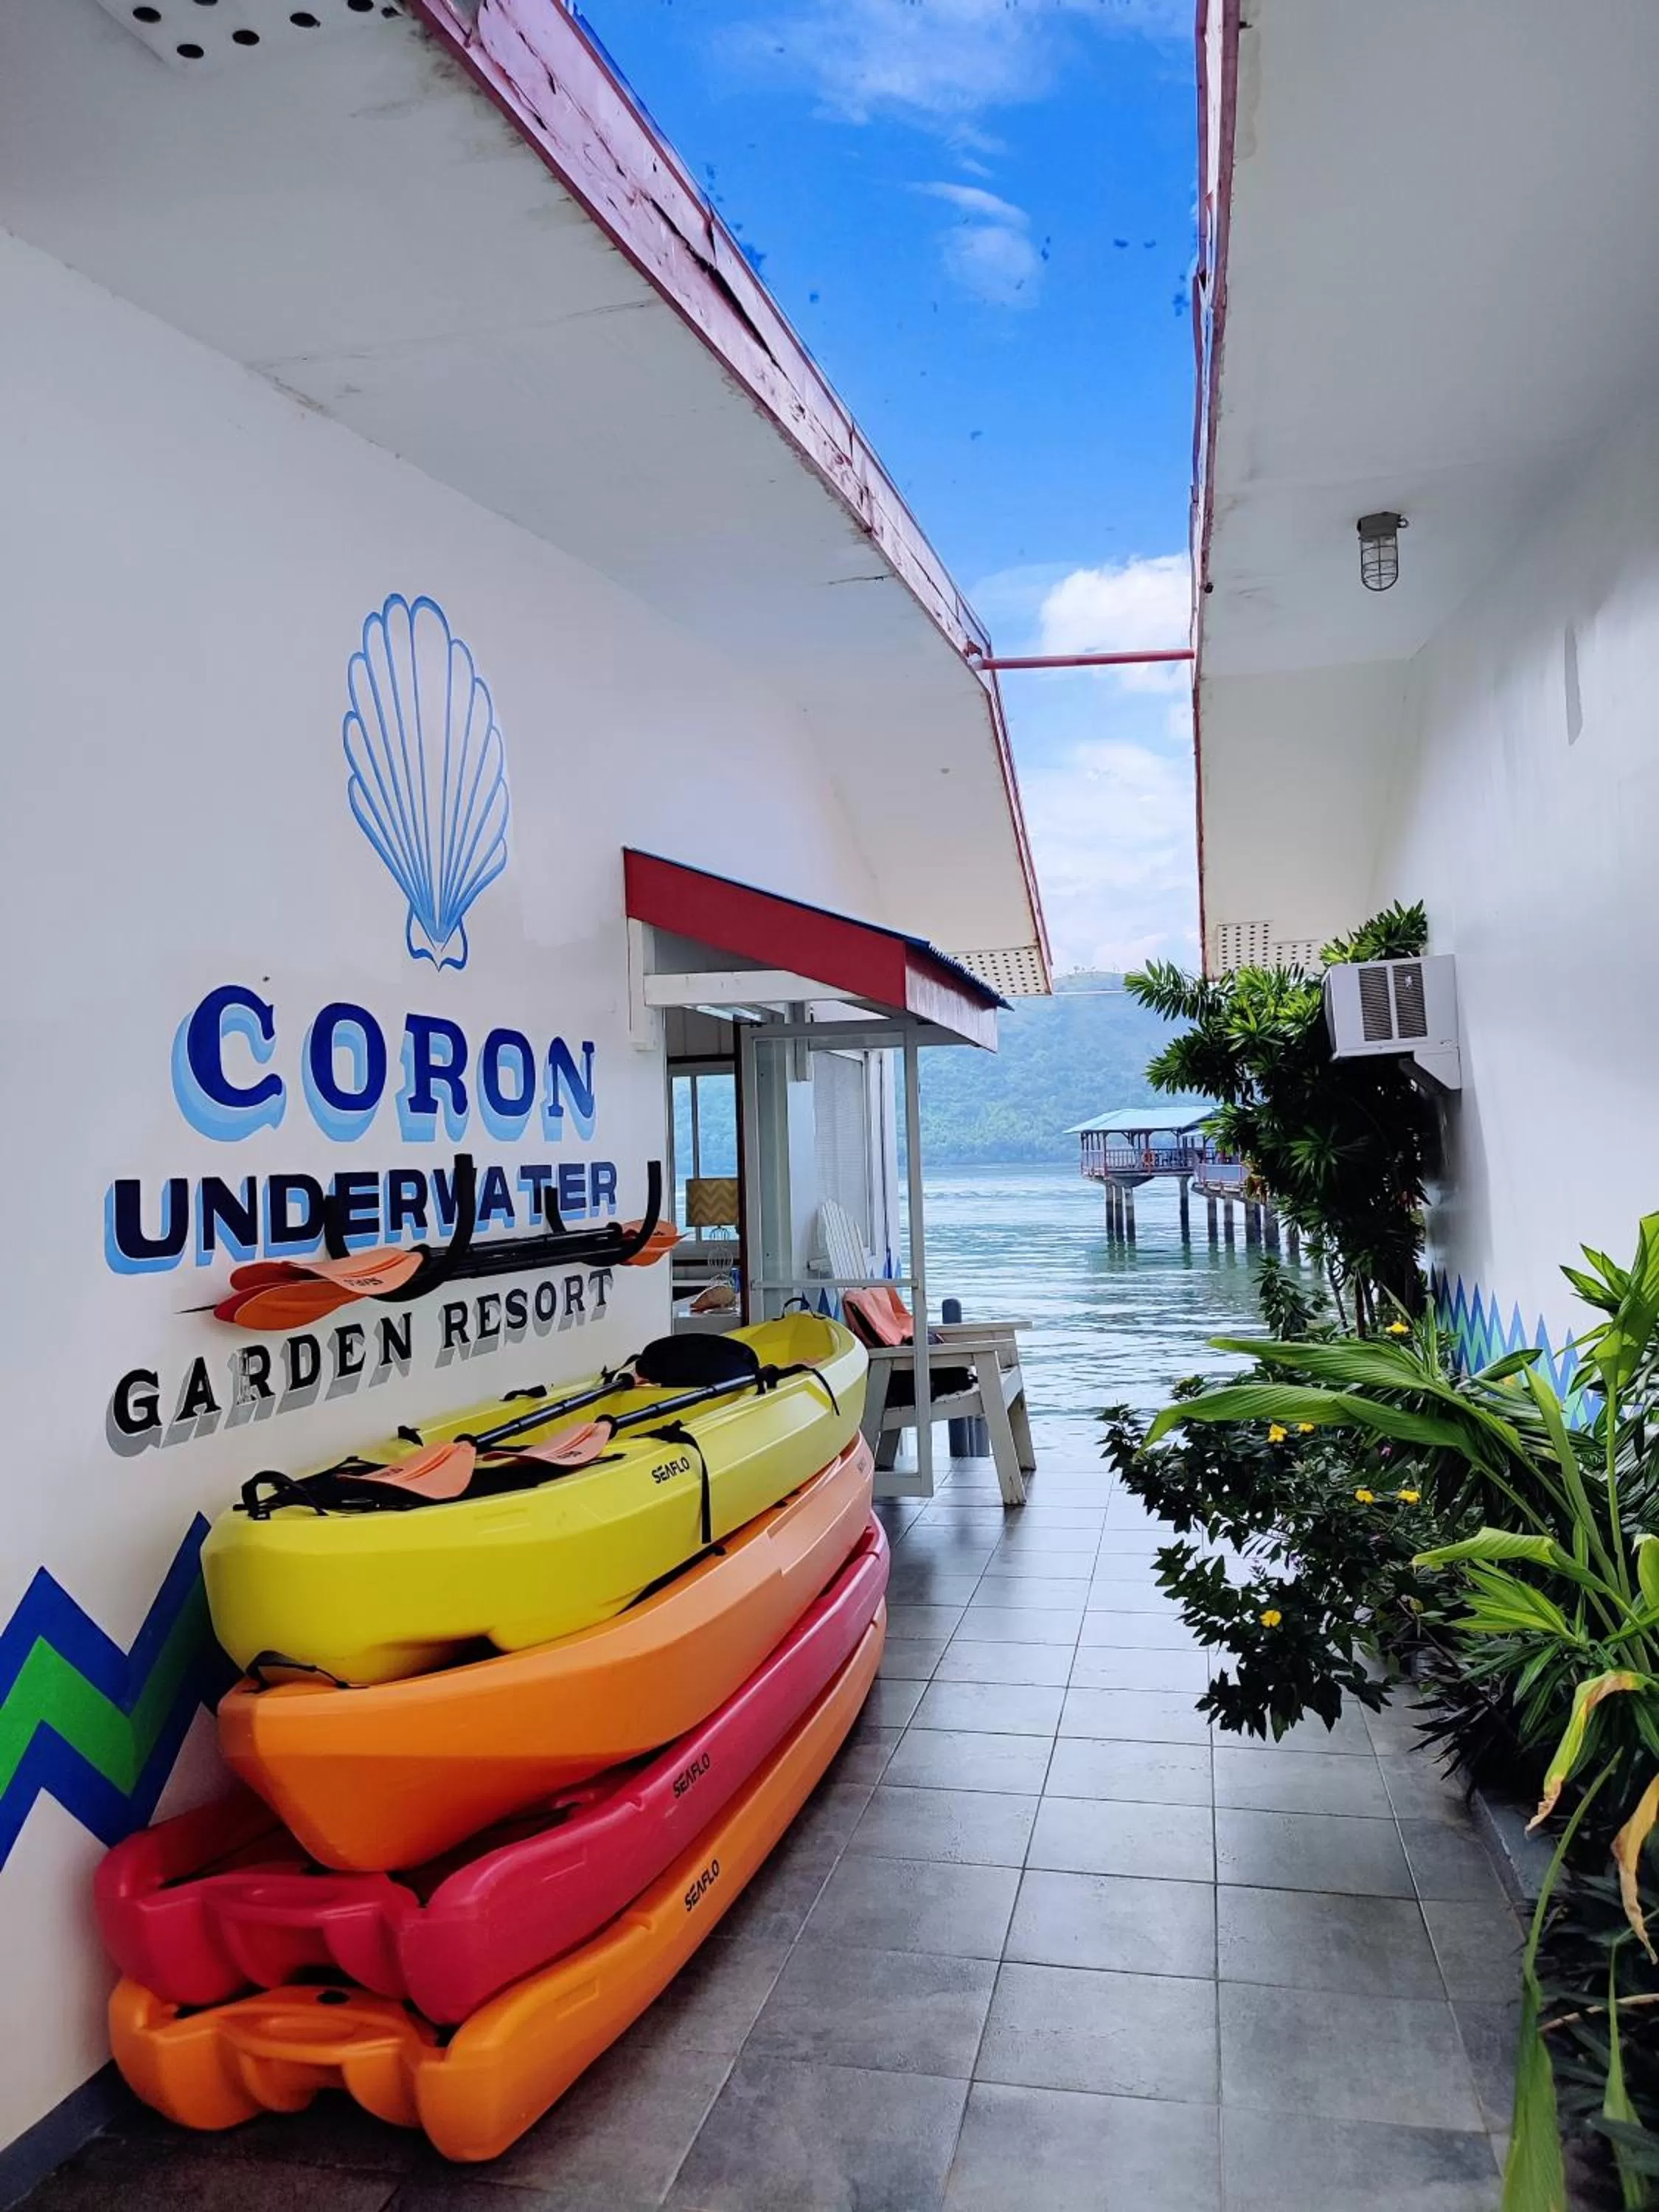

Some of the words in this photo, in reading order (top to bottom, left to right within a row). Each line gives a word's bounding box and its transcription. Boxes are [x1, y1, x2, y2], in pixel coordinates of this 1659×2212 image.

[186, 985, 596, 1119] CORON
[112, 1311, 413, 1434] GARDEN
[442, 1268, 614, 1349] RESORT
[651, 1456, 690, 1484] SEAFLO
[672, 1752, 710, 1799] SEAFLO
[684, 1858, 720, 1912] SEAFLO
